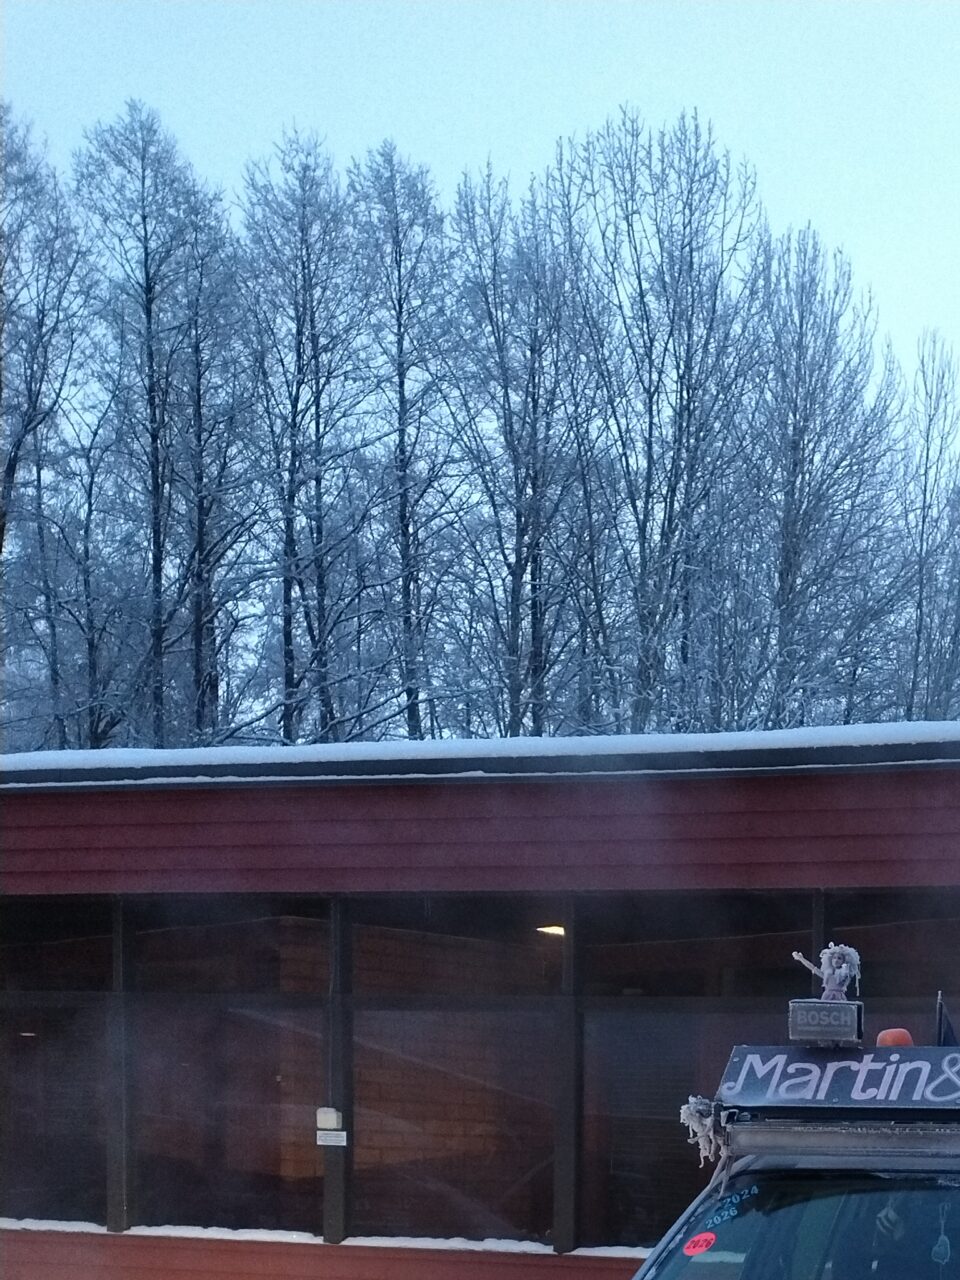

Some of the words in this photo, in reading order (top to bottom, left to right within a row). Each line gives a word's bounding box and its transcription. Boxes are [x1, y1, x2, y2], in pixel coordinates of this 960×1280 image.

[796, 1010, 851, 1026] BOSCH
[722, 1185, 759, 1208] 2024
[705, 1207, 738, 1229] 2026
[685, 1238, 714, 1249] 2026
